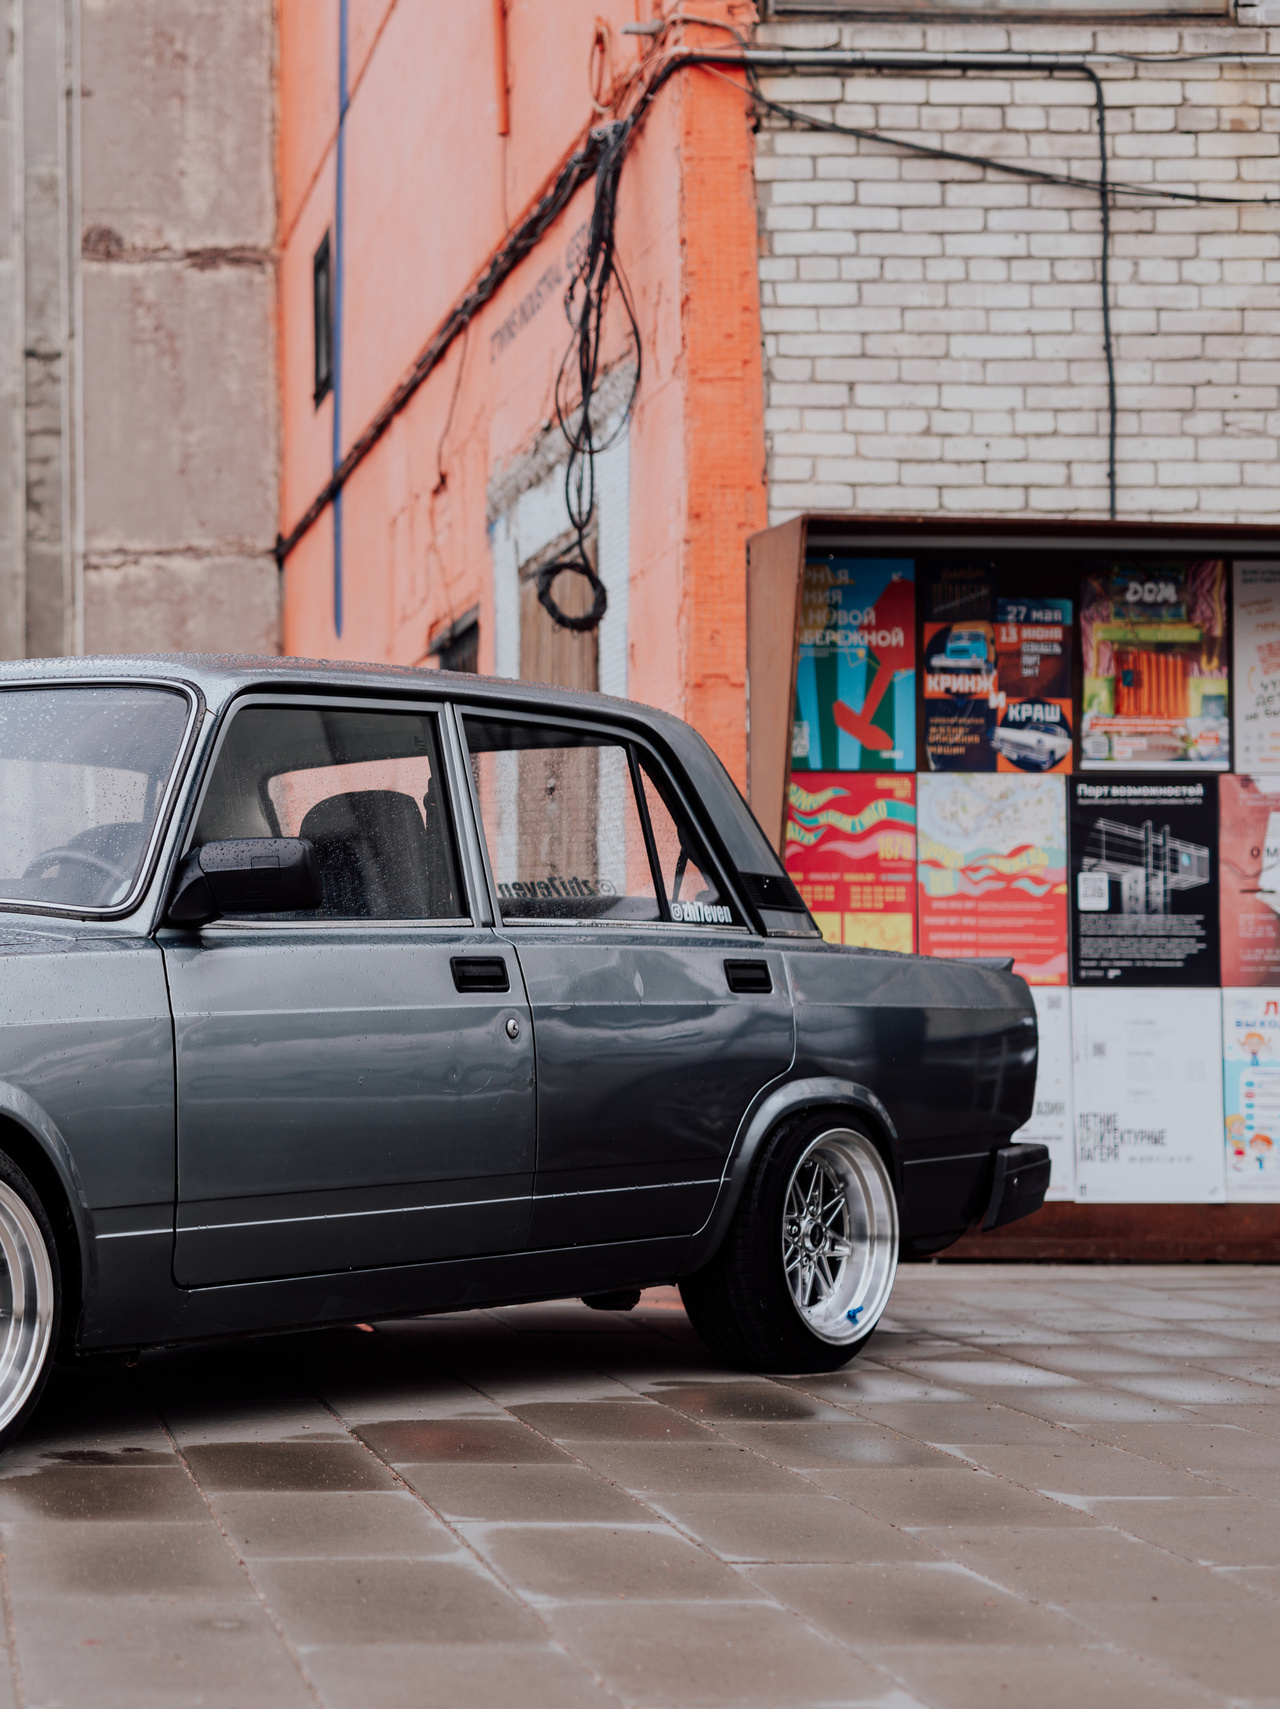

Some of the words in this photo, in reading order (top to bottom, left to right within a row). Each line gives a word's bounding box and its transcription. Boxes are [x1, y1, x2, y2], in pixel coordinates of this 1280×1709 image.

[808, 605, 876, 627] НОВОЙ
[1006, 605, 1027, 622] 27
[800, 626, 904, 647] БЕРЕЖНОЙ
[926, 674, 995, 693] КРИНЖ
[1008, 703, 1061, 722] КРАШ
[1077, 783, 1110, 799] Порт
[1111, 783, 1204, 798] возможностей
[1078, 1112, 1119, 1130] ЛЕТНИЕ
[1078, 1127, 1167, 1147] АРХИТЕКТУРНЫЕ
[1078, 1145, 1120, 1164] ЛАГЕРЯ
